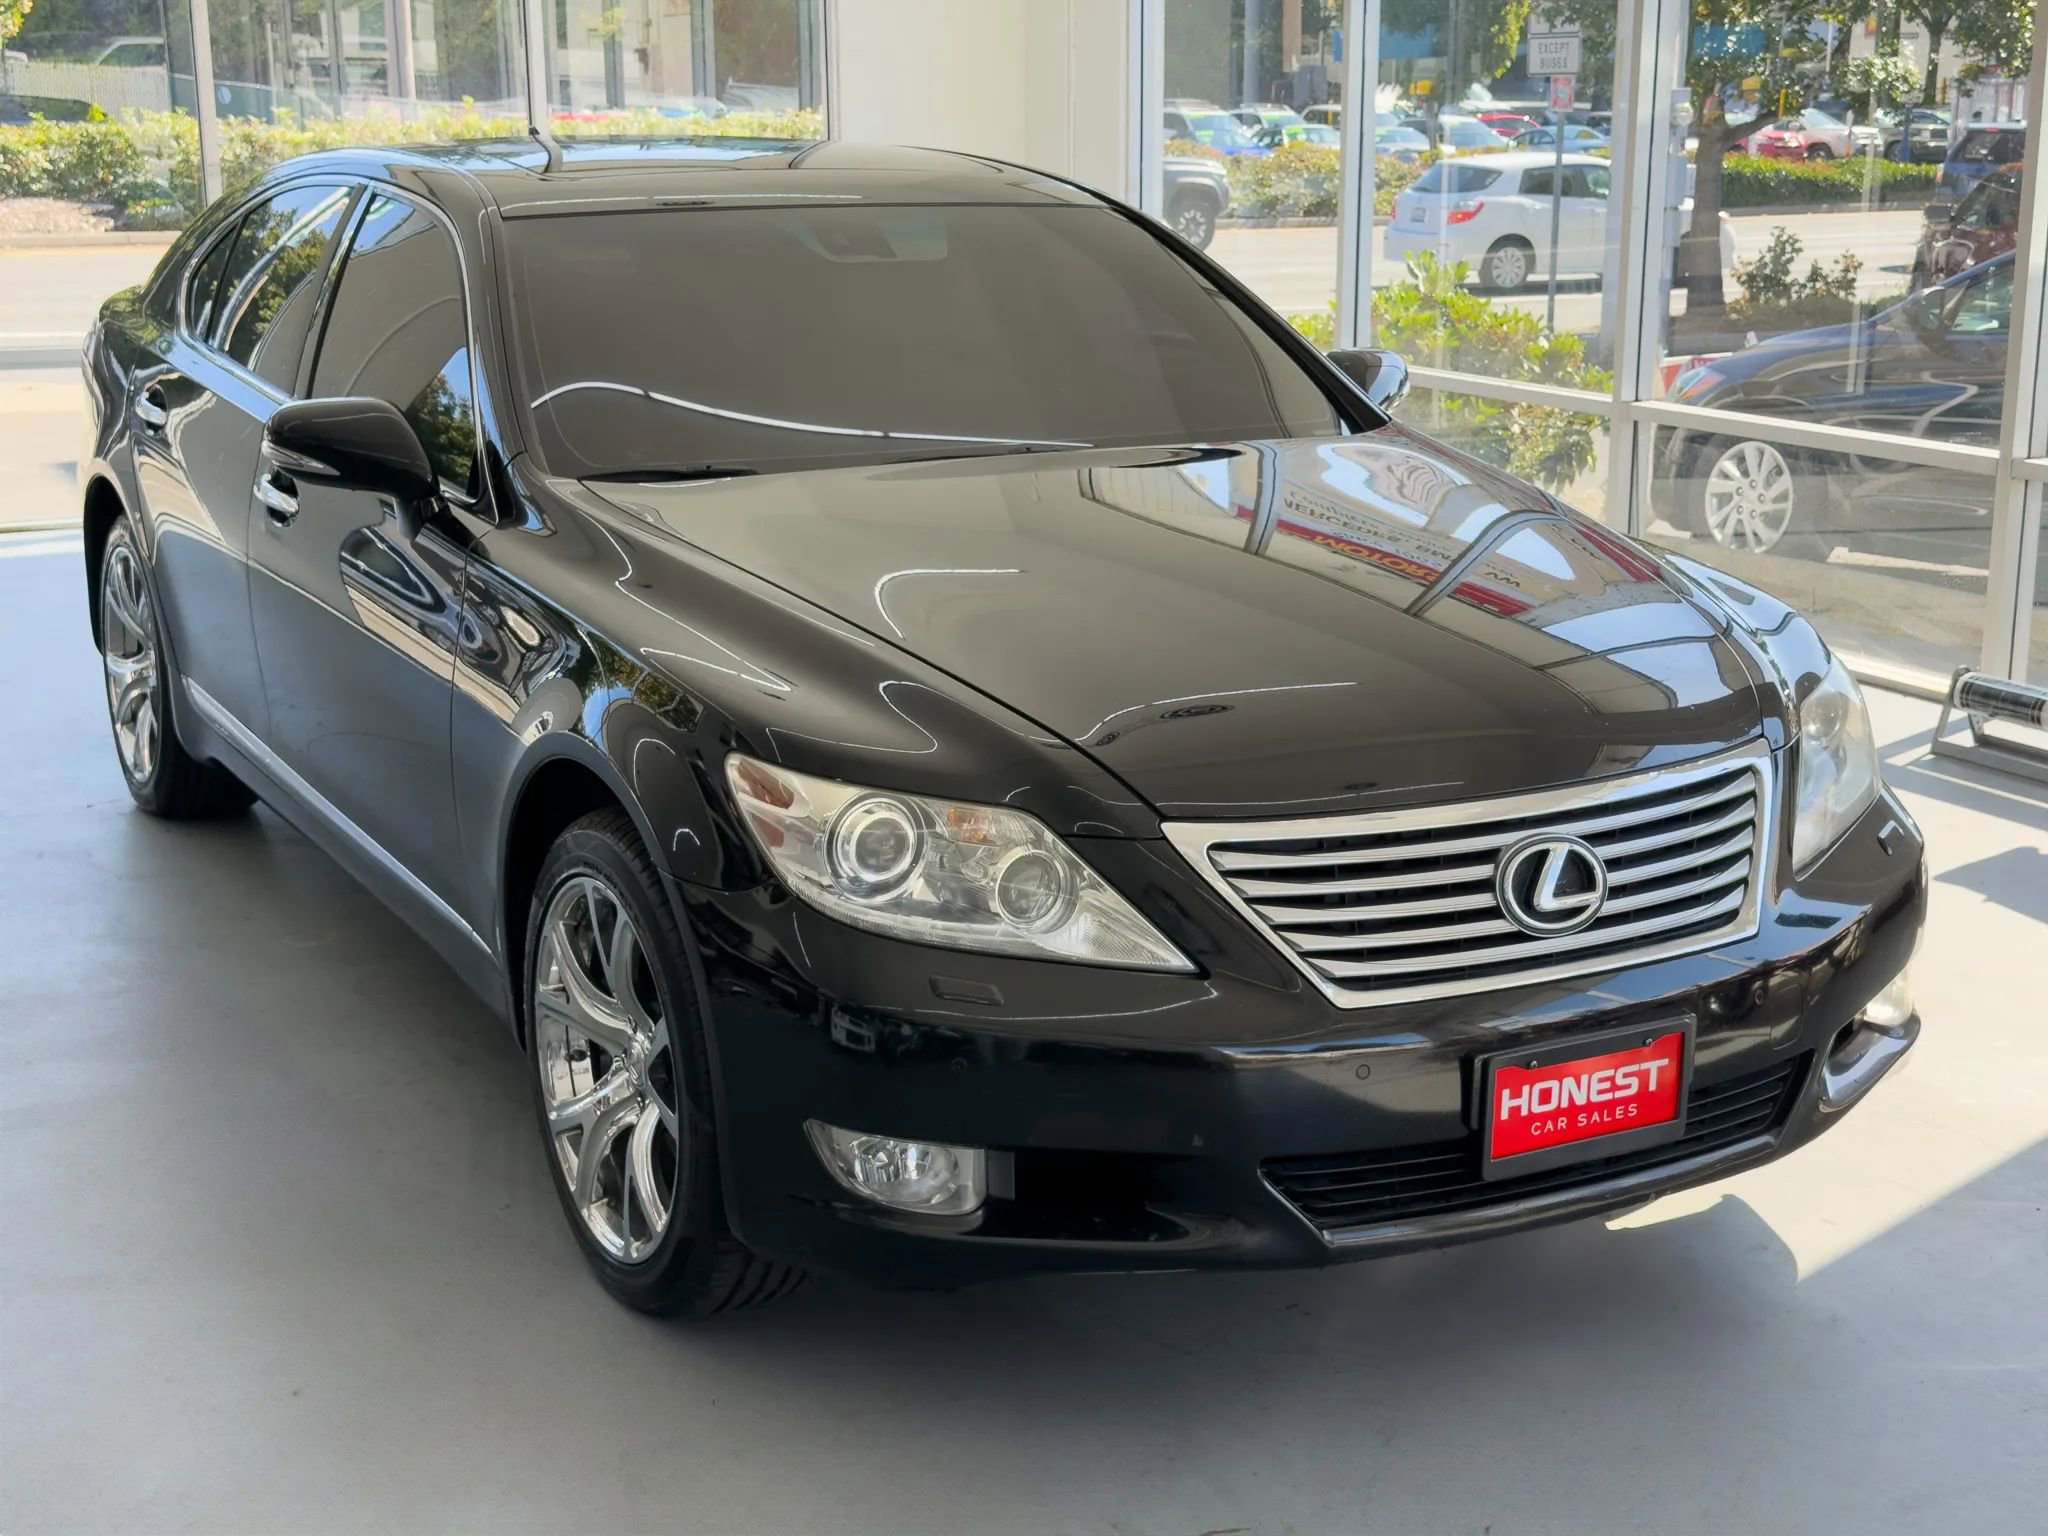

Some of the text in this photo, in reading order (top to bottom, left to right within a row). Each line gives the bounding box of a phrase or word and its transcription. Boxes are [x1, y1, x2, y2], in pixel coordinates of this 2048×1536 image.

[1538, 42, 1569, 54] EXCEPT
[1501, 1058, 1669, 1120] HONEST
[1531, 1104, 1638, 1135] CAR SALES
